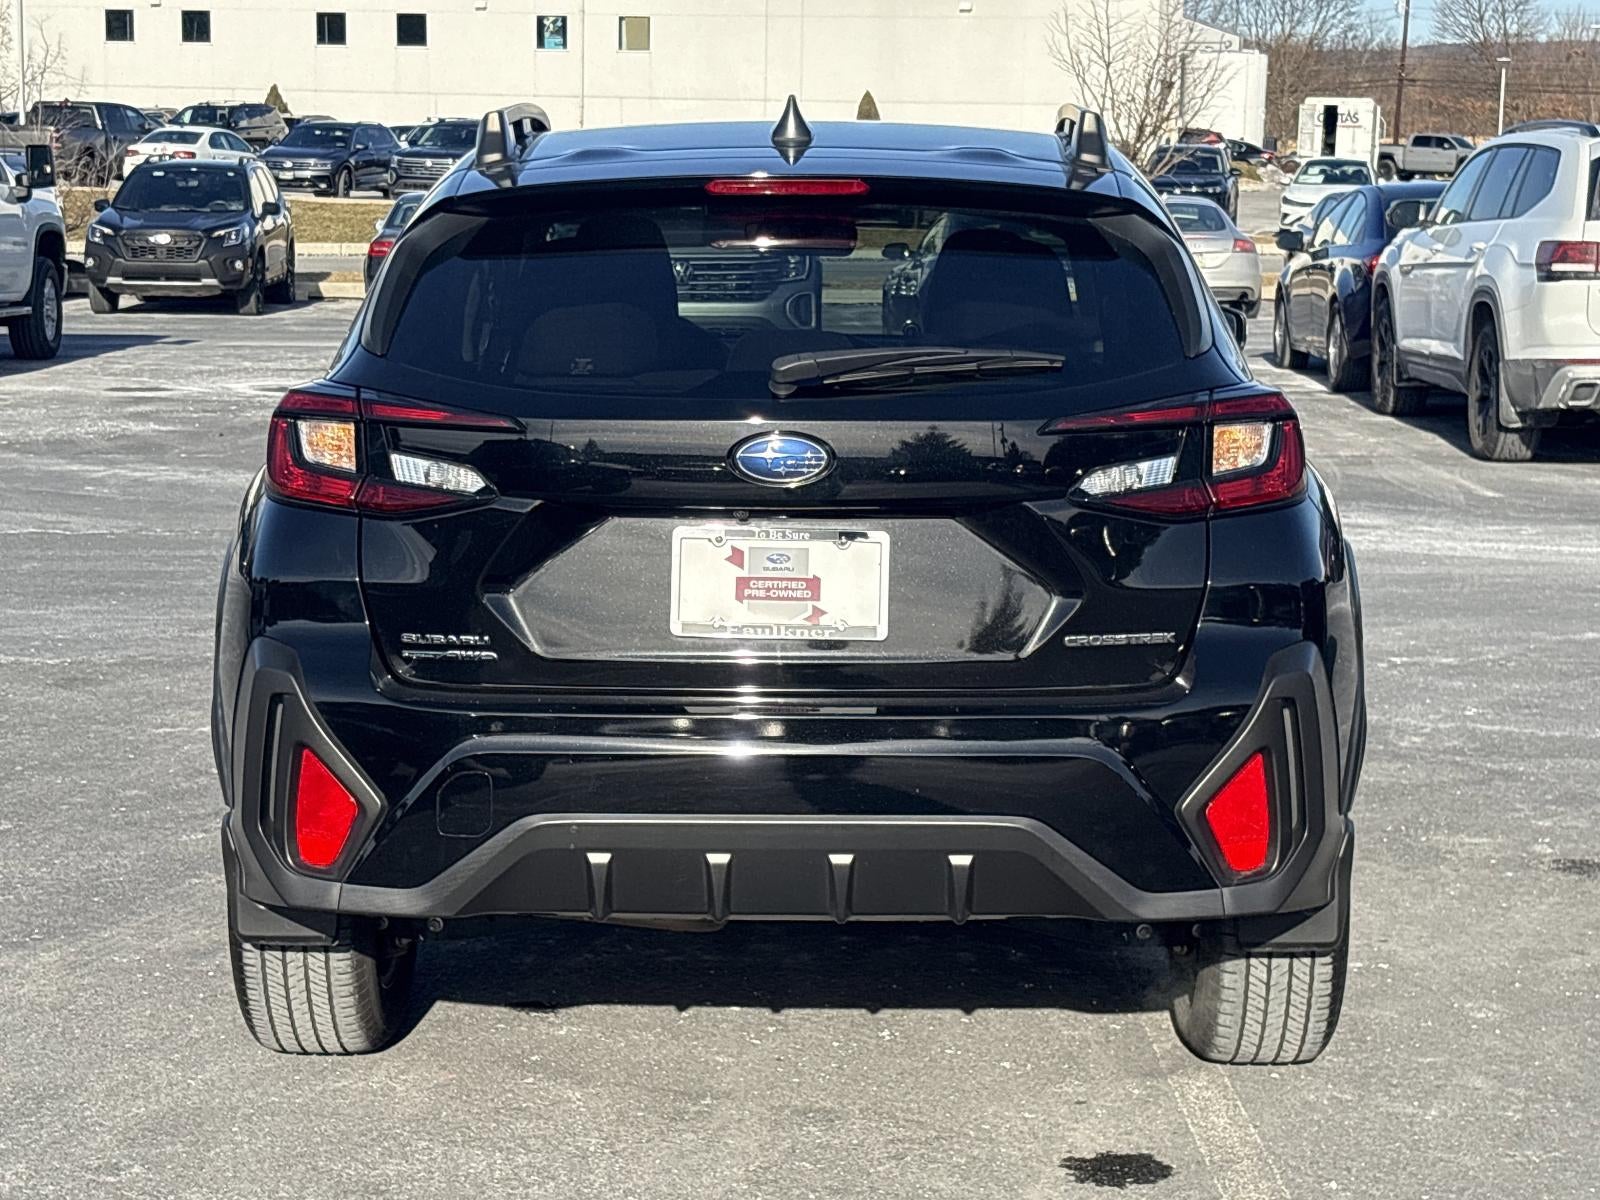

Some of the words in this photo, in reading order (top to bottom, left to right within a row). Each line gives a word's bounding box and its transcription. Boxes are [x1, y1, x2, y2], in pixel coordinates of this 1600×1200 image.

[1317, 111, 1359, 124] CTAS
[754, 529, 766, 539] To
[769, 530, 783, 540] Be
[785, 530, 811, 541] Sure
[749, 580, 807, 589] CERTIFIED
[744, 589, 812, 599] PRE-OWNED
[726, 624, 836, 639] Faulkner
[400, 632, 491, 646] SUBARU
[1063, 631, 1176, 648] CROSSTREK
